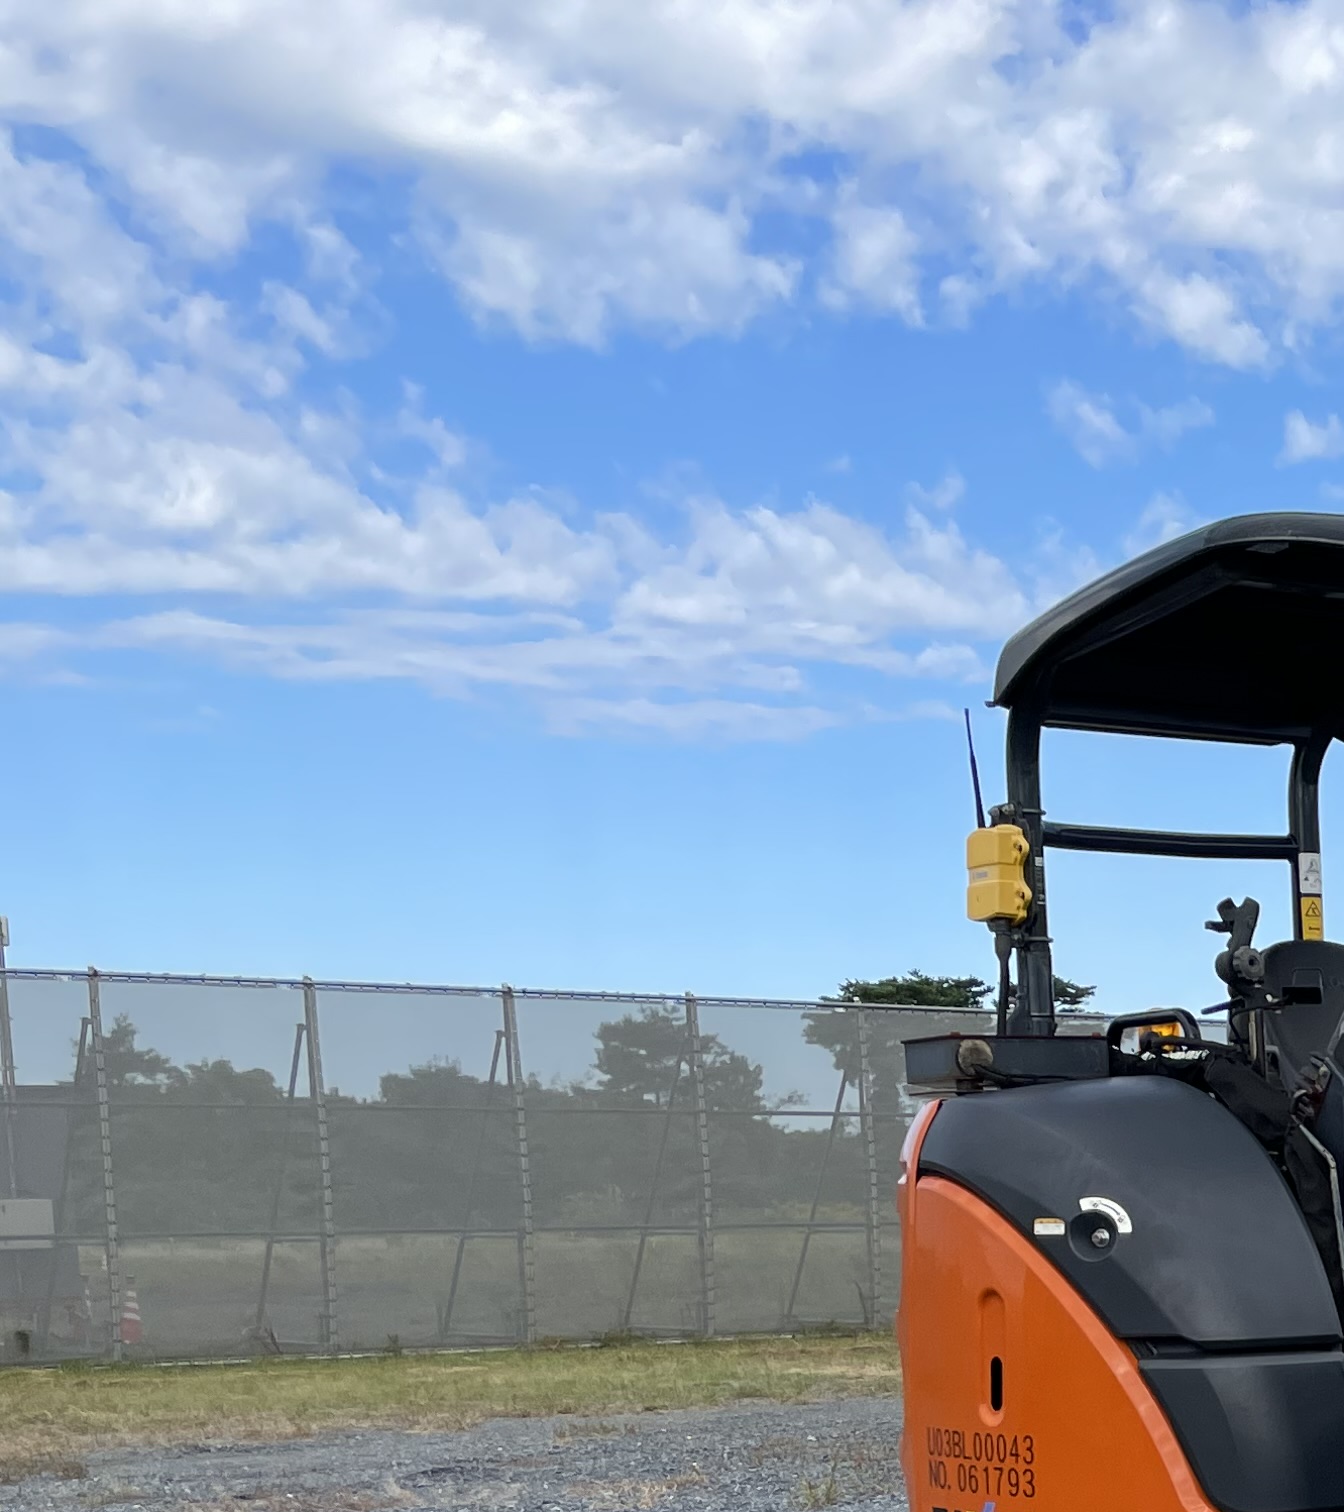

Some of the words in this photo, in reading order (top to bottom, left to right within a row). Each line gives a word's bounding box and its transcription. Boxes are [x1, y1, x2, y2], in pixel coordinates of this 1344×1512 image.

[926, 1427, 1035, 1465] U03BL00043
[928, 1461, 951, 1490] NO.
[957, 1465, 1036, 1498] 061793
